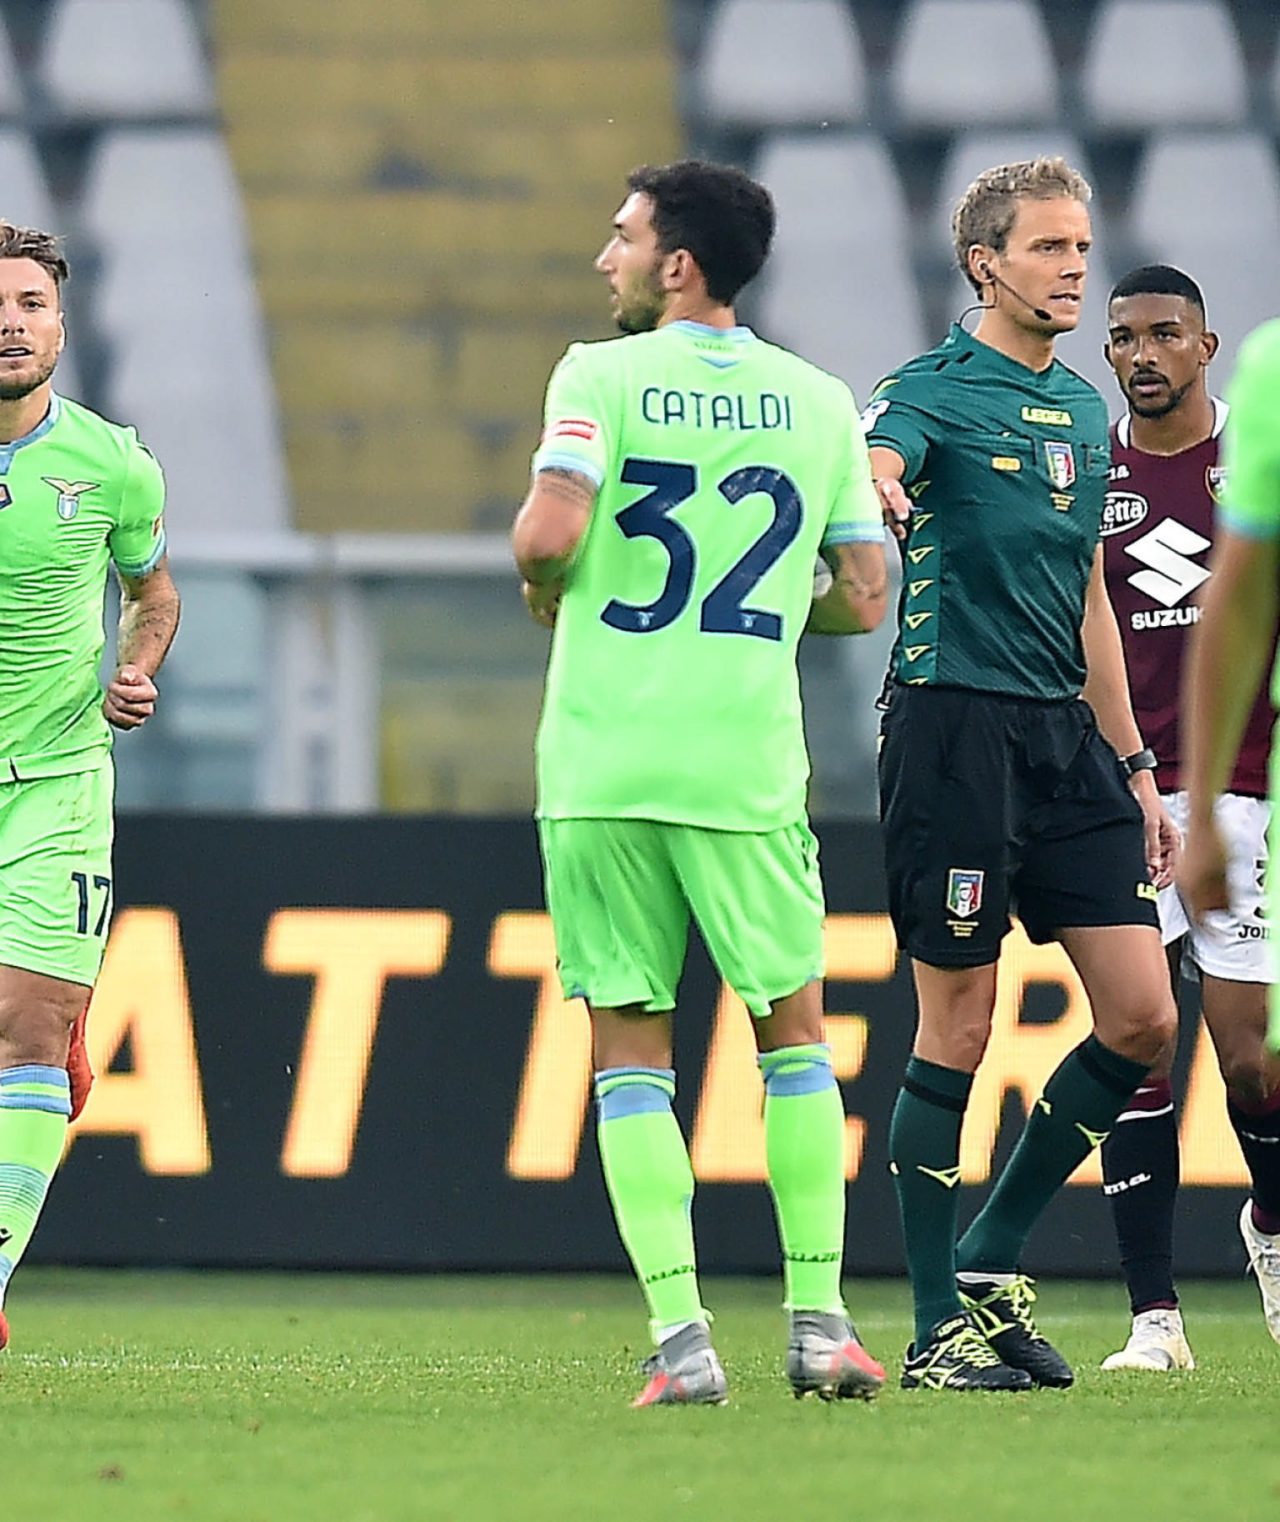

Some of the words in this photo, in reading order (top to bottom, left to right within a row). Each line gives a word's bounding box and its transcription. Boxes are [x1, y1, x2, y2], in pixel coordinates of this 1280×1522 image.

[642, 387, 791, 431] CATALDI
[1103, 500, 1142, 522] etta
[600, 458, 802, 641] 32
[1131, 606, 1205, 631] SUZUK
[71, 871, 111, 937] 17
